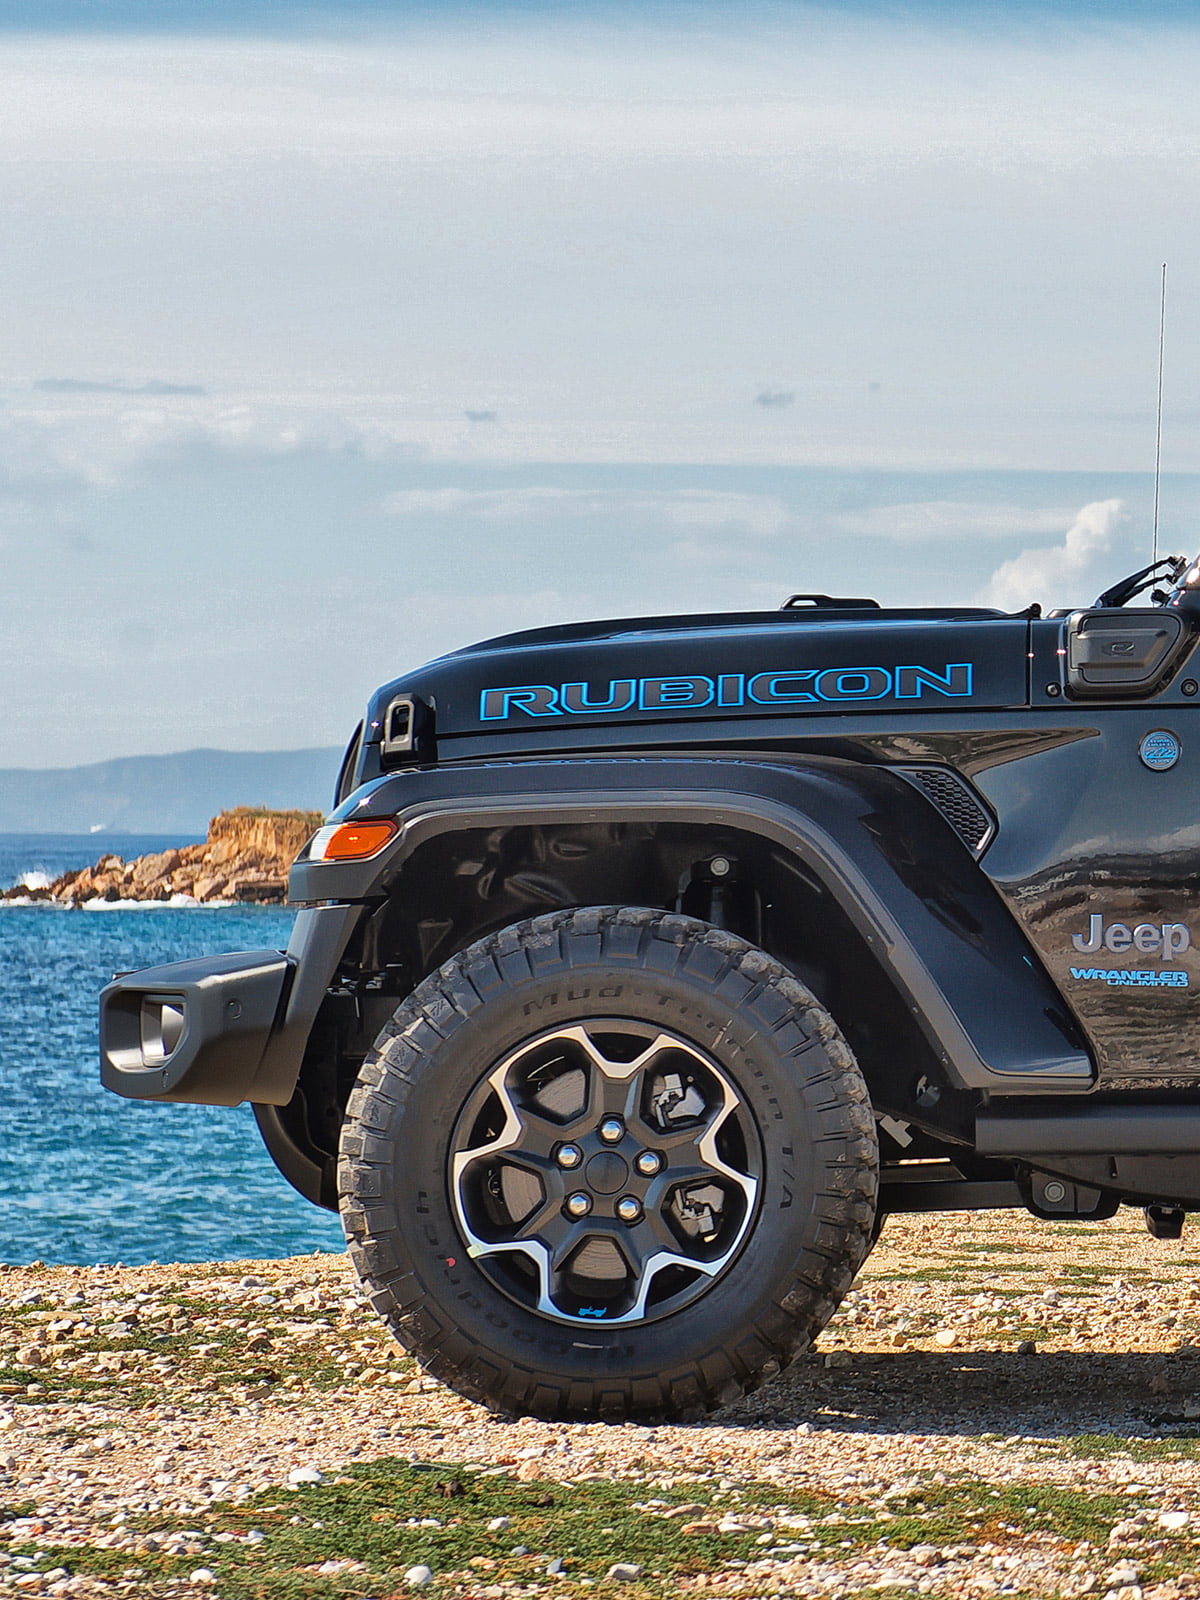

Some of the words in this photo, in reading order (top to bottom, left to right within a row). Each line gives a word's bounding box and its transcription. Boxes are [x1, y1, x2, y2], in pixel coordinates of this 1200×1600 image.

[480, 663, 973, 721] RUBICON
[1071, 912, 1191, 961] Jeep
[1070, 967, 1189, 981] WRANGLER
[1107, 979, 1189, 988] UNLIMITED
